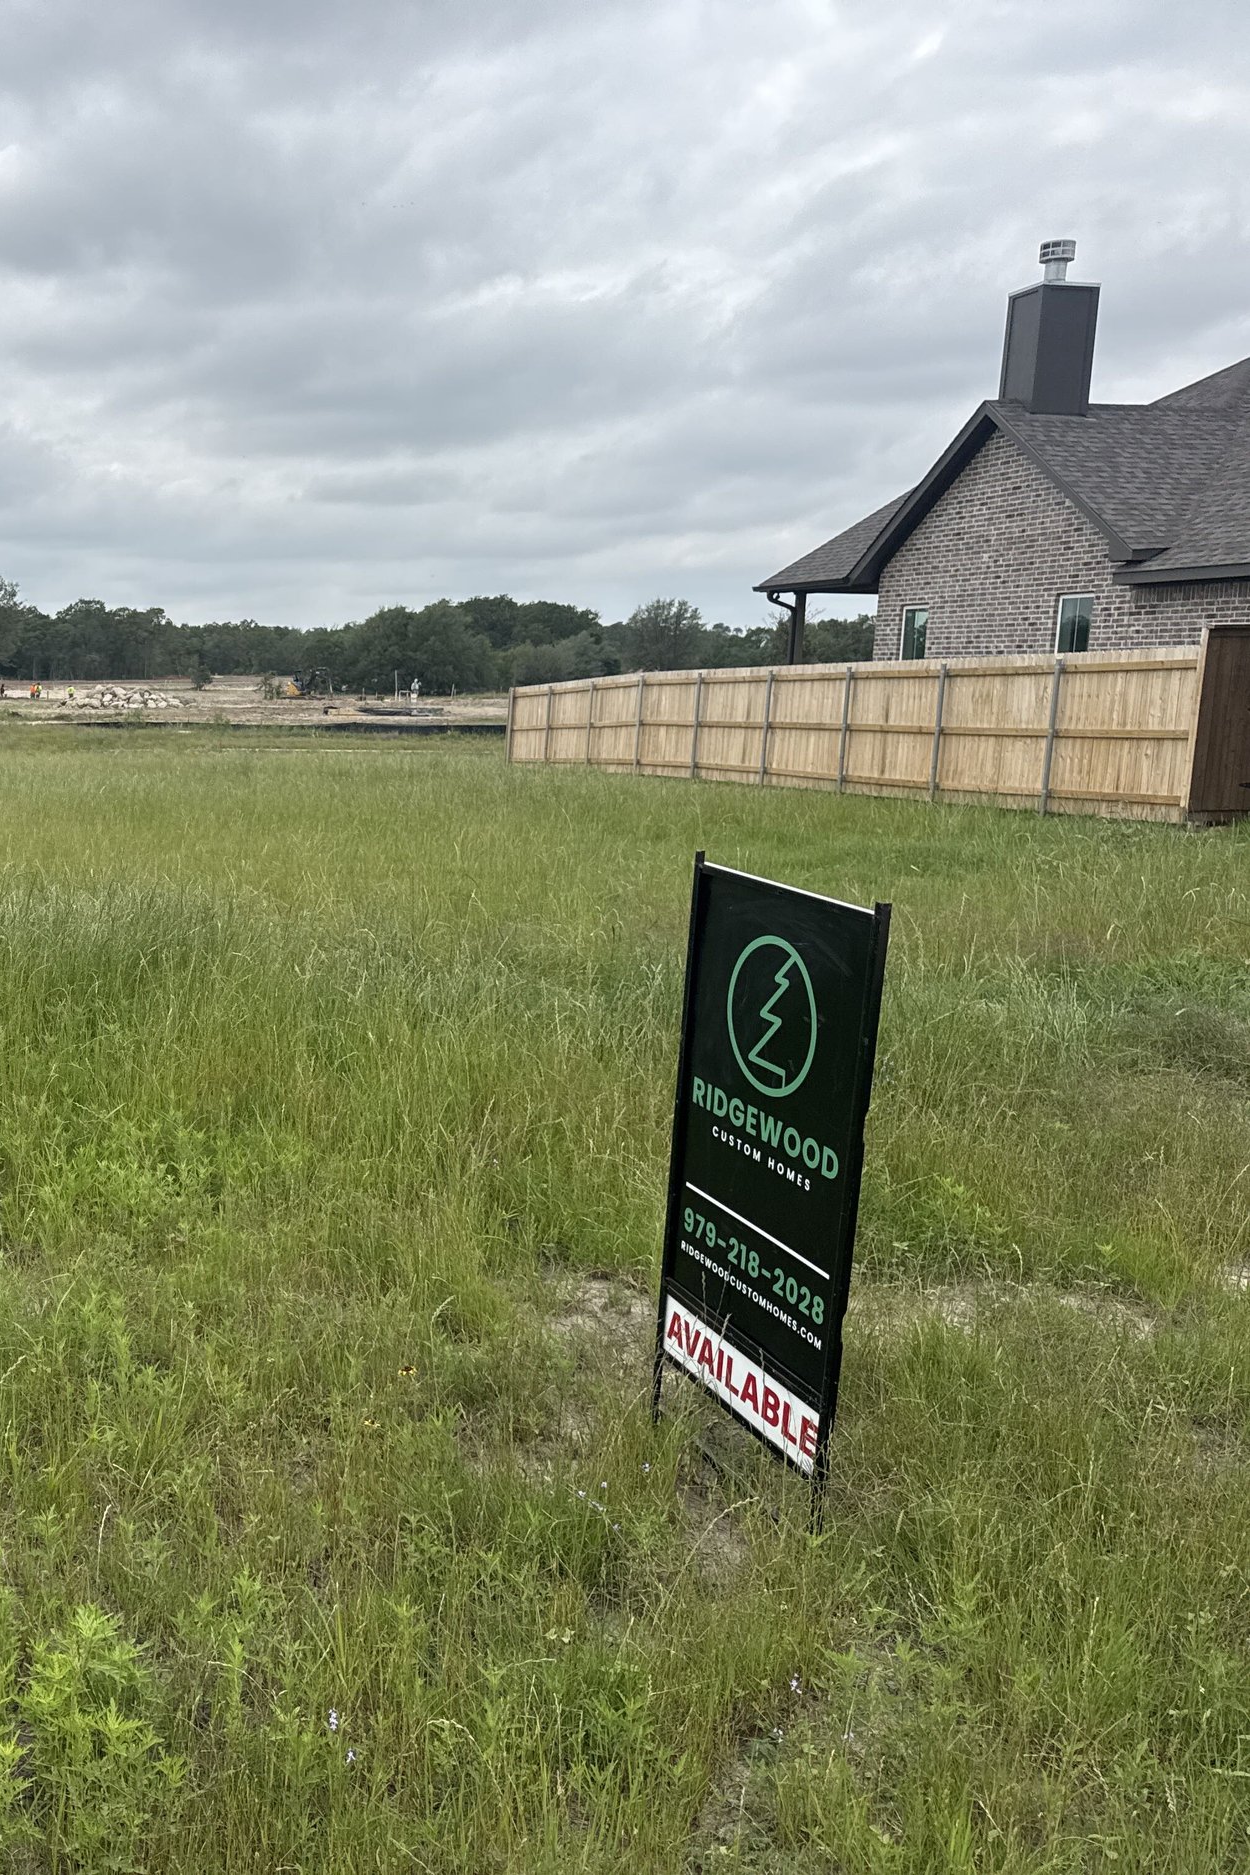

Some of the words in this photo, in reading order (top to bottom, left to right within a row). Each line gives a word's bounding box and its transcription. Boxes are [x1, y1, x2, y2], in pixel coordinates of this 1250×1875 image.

[692, 1076, 839, 1180] RIDGEWOOD
[712, 1126, 761, 1162] CUSTOM
[768, 1157, 811, 1191] HOMES
[680, 1240, 822, 1350] RIDGEWOODCUSTOMHOMES.COM
[684, 1207, 825, 1325] 979-218-2028
[667, 1311, 818, 1459] AVAILABLE
